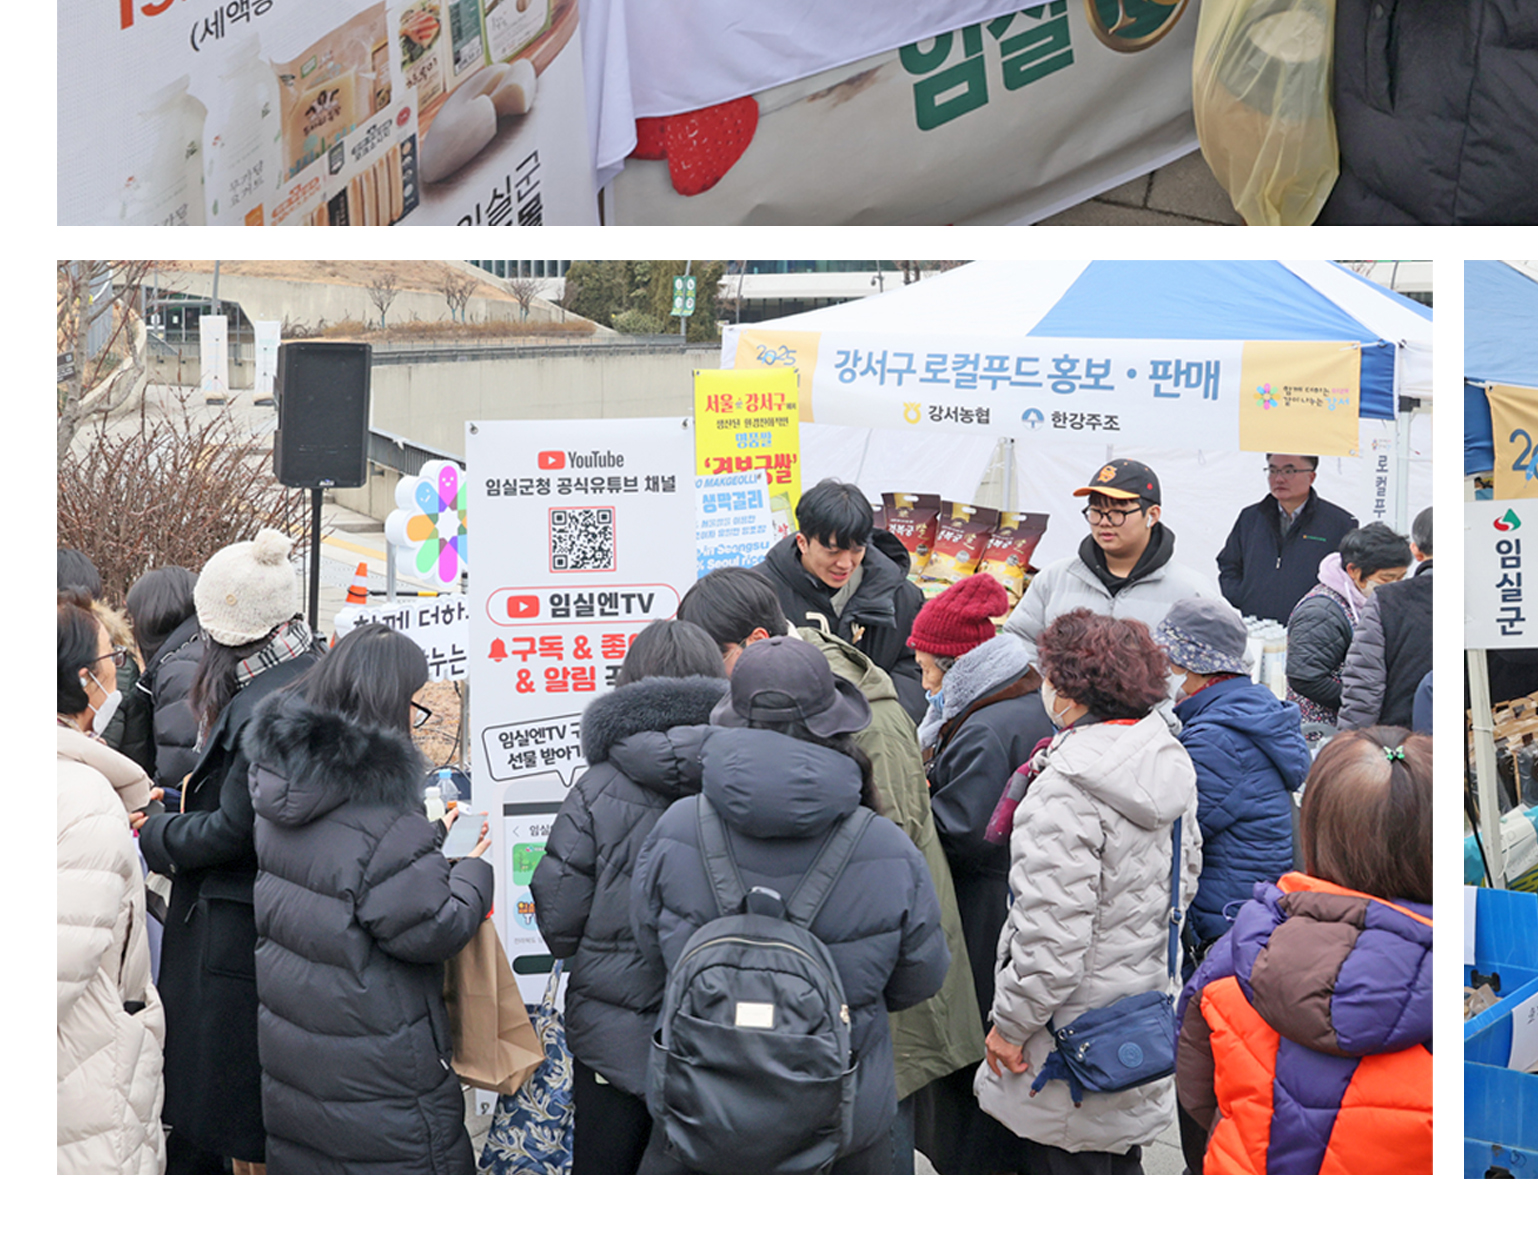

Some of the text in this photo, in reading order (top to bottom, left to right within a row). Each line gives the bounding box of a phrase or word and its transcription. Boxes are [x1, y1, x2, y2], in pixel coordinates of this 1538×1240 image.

[756, 344, 797, 366] 2025
[834, 350, 1222, 401] 강서구 로컬푸드 홍보 판매
[705, 393, 734, 413] 서울
[927, 405, 991, 425] 강서농협
[1051, 411, 1121, 432] 한강주조
[735, 431, 773, 449] 명품쌀
[567, 451, 625, 469] YouTube
[486, 475, 676, 496] 임실군청 공식유튜브 채널
[702, 489, 764, 514] 생막걸리
[1494, 538, 1527, 636] 임실군
[550, 592, 655, 618] 임실엔TV
[511, 635, 564, 662] 구독
[573, 635, 593, 660] &
[515, 668, 536, 694] &
[544, 665, 597, 693] 알림
[498, 725, 567, 750] 임실엔TV
[507, 751, 537, 771] 선물
